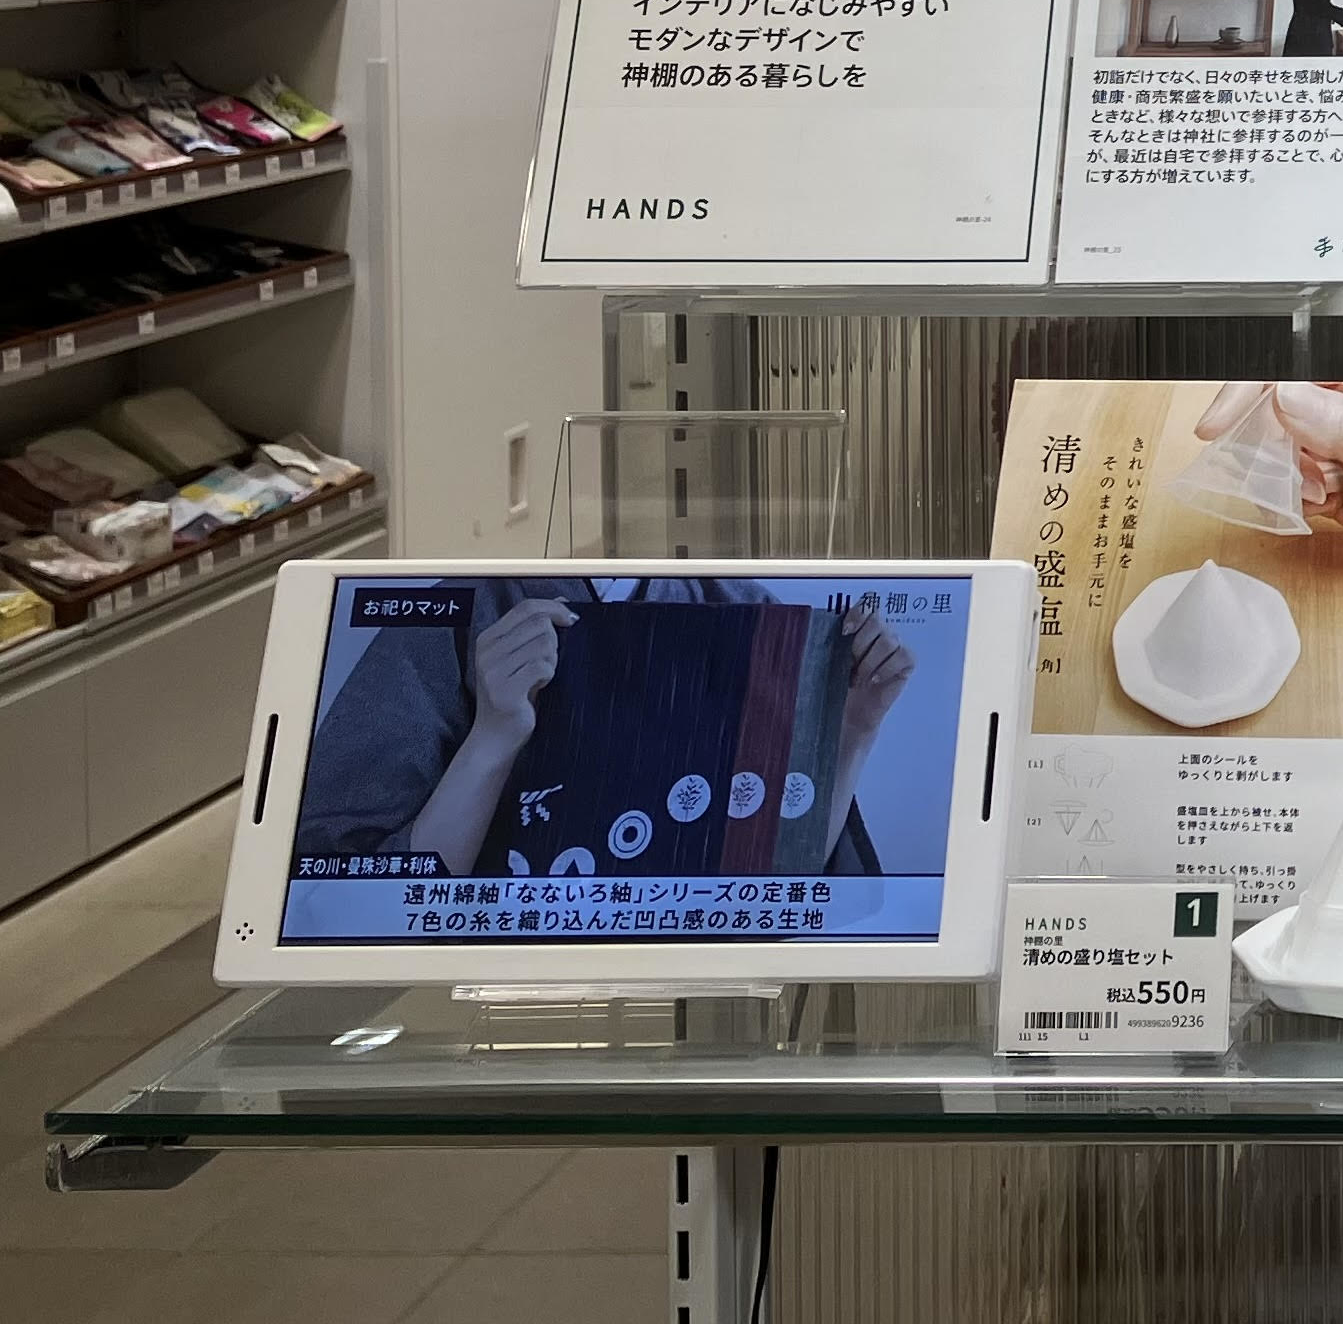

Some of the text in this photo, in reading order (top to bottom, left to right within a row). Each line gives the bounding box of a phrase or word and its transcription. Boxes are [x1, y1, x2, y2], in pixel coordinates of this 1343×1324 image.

[627, 26, 866, 53] モダンなデザインで
[620, 62, 867, 90] 神棚のある暮らしを
[1085, 166, 1257, 185] にする方が増えています。
[585, 197, 710, 220] HANDS
[1118, 436, 1146, 570] きれいな盛塩を
[1087, 455, 1117, 608] そのままお手元に
[362, 596, 461, 619] お祀りマット
[860, 590, 953, 615] 神棚の里
[1178, 754, 1259, 766] 上面のシールを
[1178, 770, 1294, 782] ゆっくりと剥がします
[1177, 835, 1208, 846] します
[402, 881, 832, 906] 遠州綿紬「なないろ紬」シリーズの定番色
[405, 908, 825, 933] 7色の糸を織り込んだ凹凸感のある生地
[1024, 917, 1088, 931] HANDS
[1187, 897, 1201, 927] 1
[1022, 948, 1174, 966] 清めの盛り塩セット
[1106, 980, 1206, 1005] 税込550円
